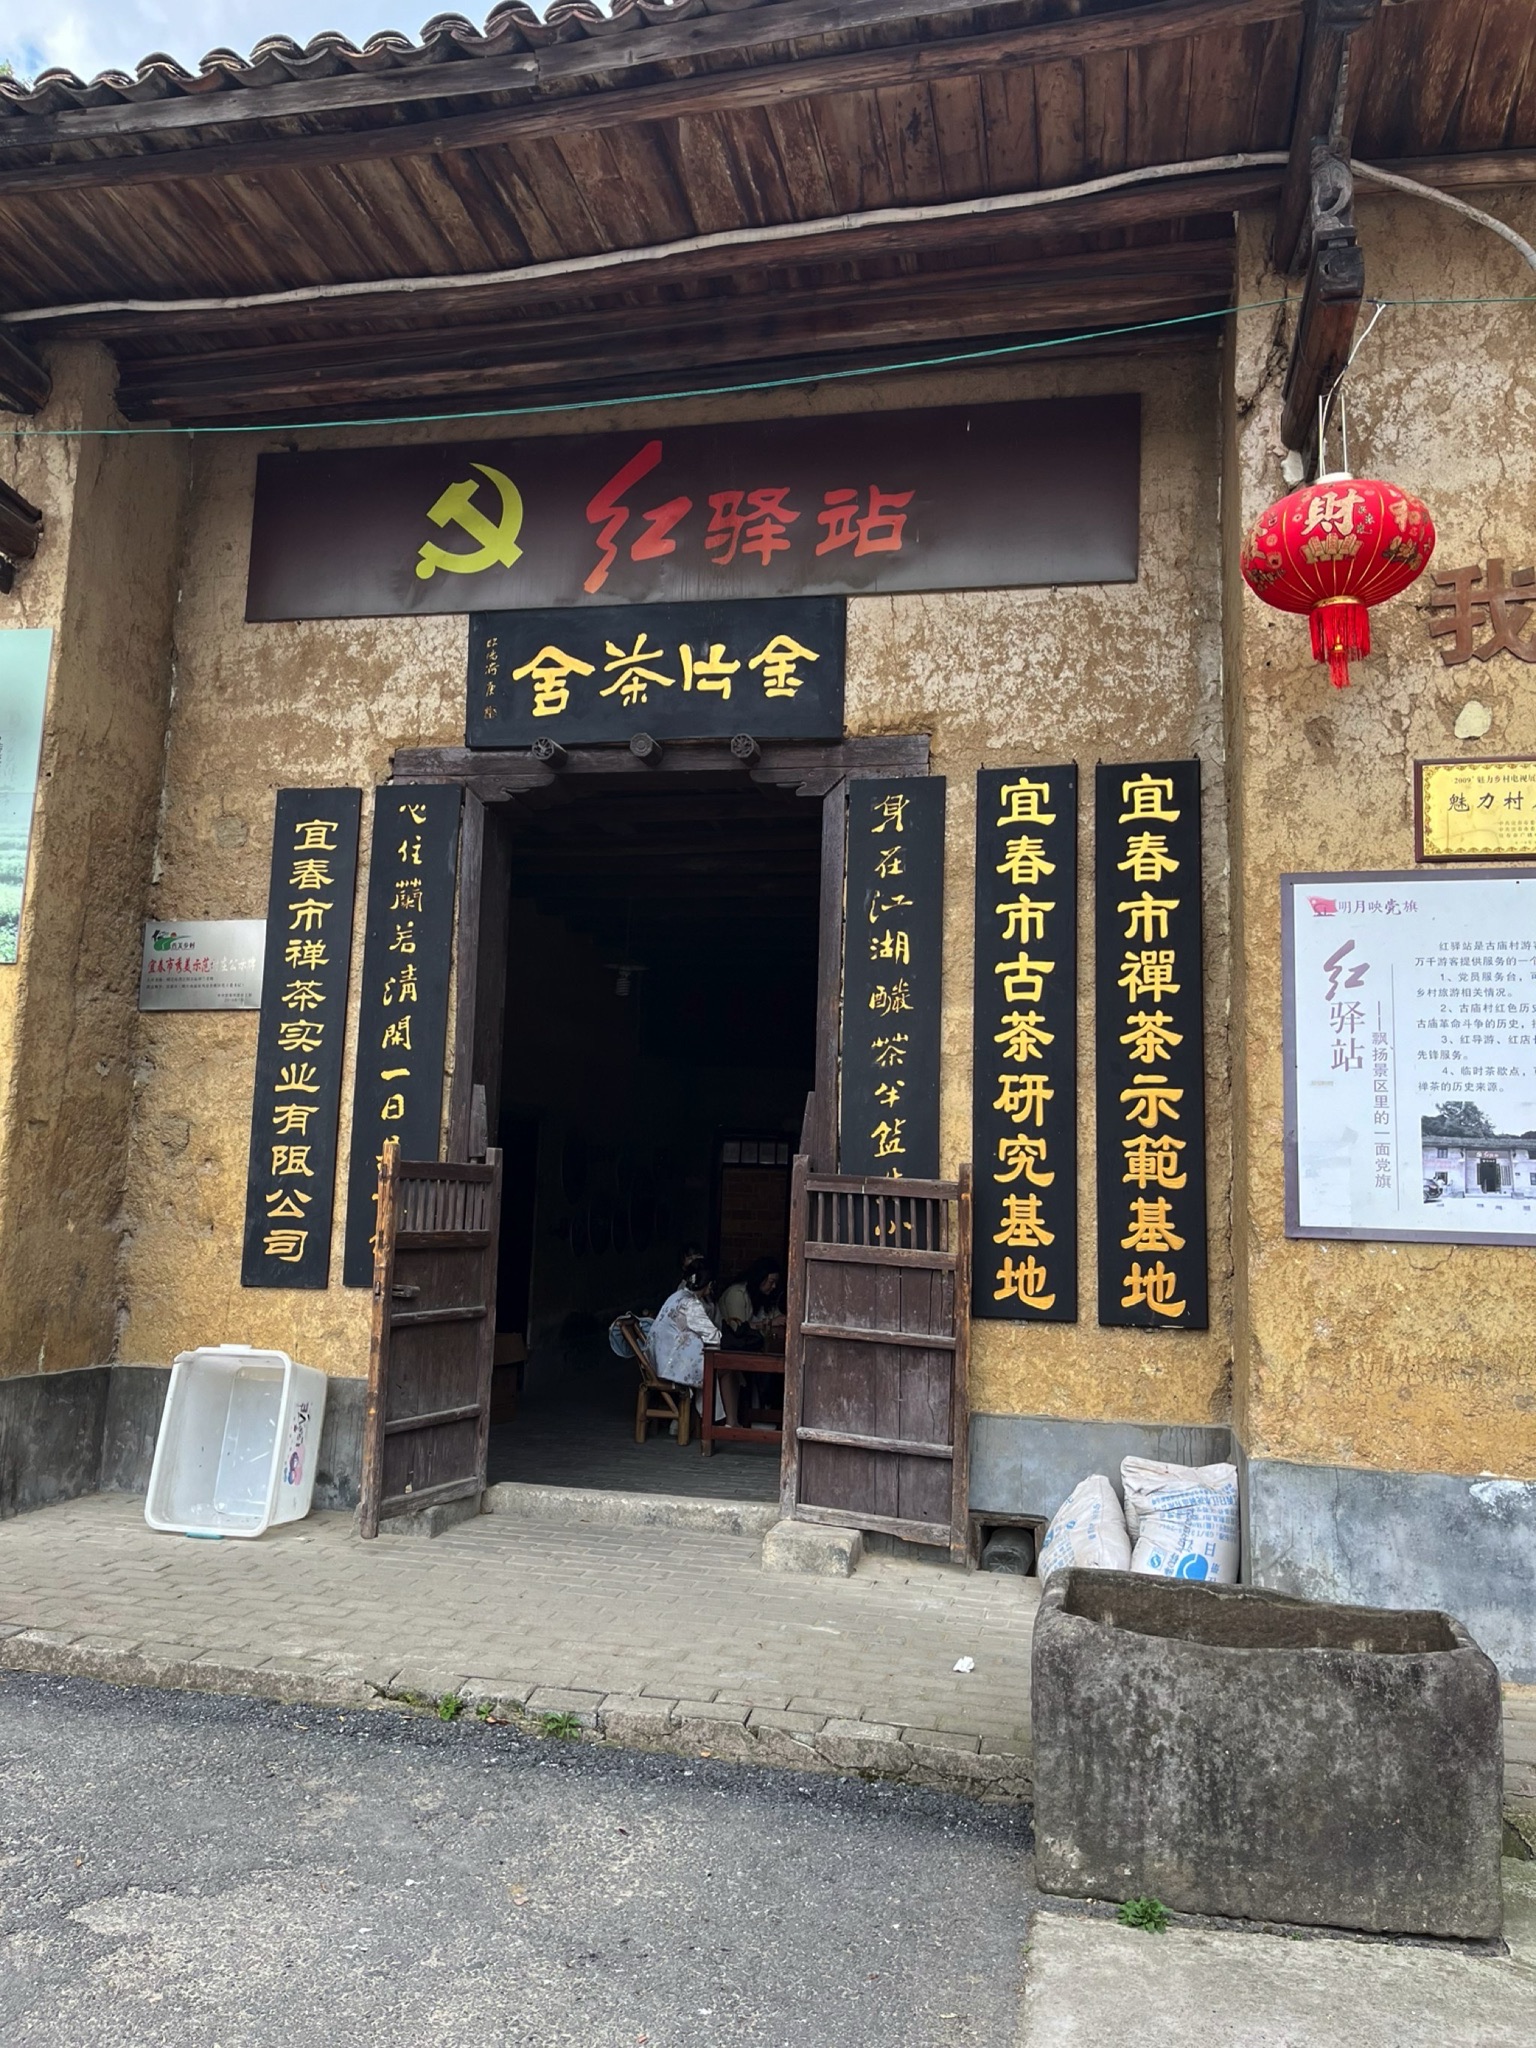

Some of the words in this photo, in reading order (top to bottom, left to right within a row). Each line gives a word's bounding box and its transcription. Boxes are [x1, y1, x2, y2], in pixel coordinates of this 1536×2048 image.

[583, 440, 914, 593] 红驿站
[1448, 791, 1536, 812] 魅力村
[1338, 898, 1418, 916] 明月映党旗
[1323, 939, 1371, 1073] 红驿站
[1416, 987, 1512, 998] 乡村旅游相关情况。
[263, 818, 340, 1264] 宜春市禅茶实业有限公司
[992, 776, 1056, 1311] 宜春市古茶研究基地
[1116, 773, 1187, 1317] 宜春市禪茶示範基地
[1417, 1049, 1468, 1060] 先锋服务。
[1418, 1081, 1504, 1092] 禅茶的历史来源。
